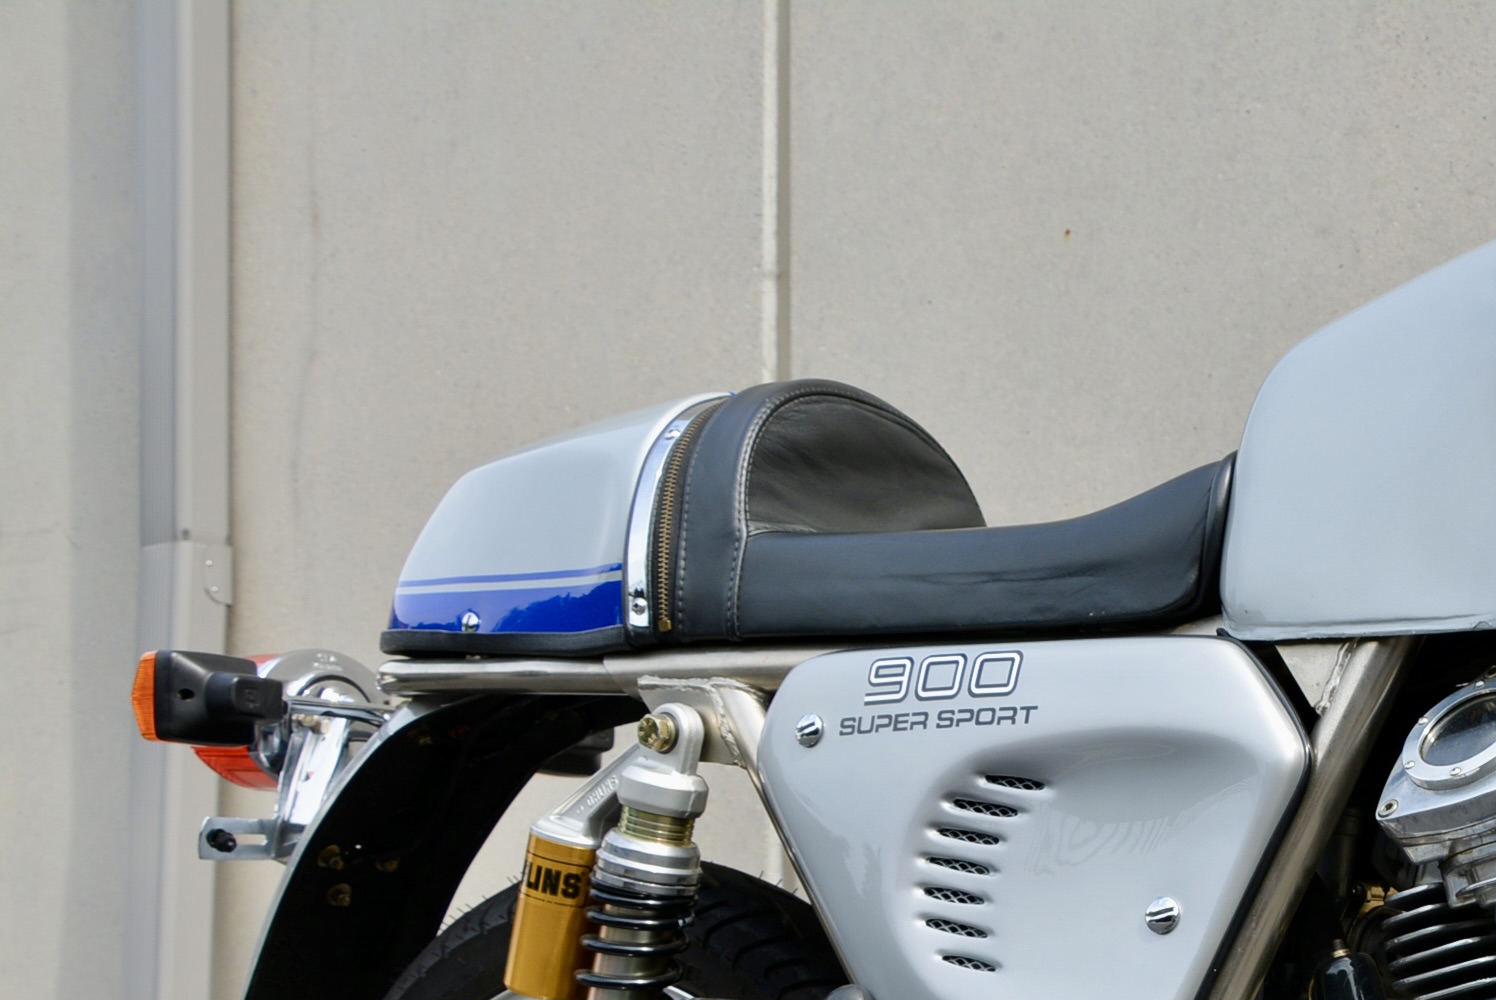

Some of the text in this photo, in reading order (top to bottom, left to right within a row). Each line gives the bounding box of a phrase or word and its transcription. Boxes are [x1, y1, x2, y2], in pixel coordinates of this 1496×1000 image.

[864, 650, 1024, 706] 900
[839, 705, 1038, 736] SUPER SPORT
[526, 861, 582, 900] LINS
